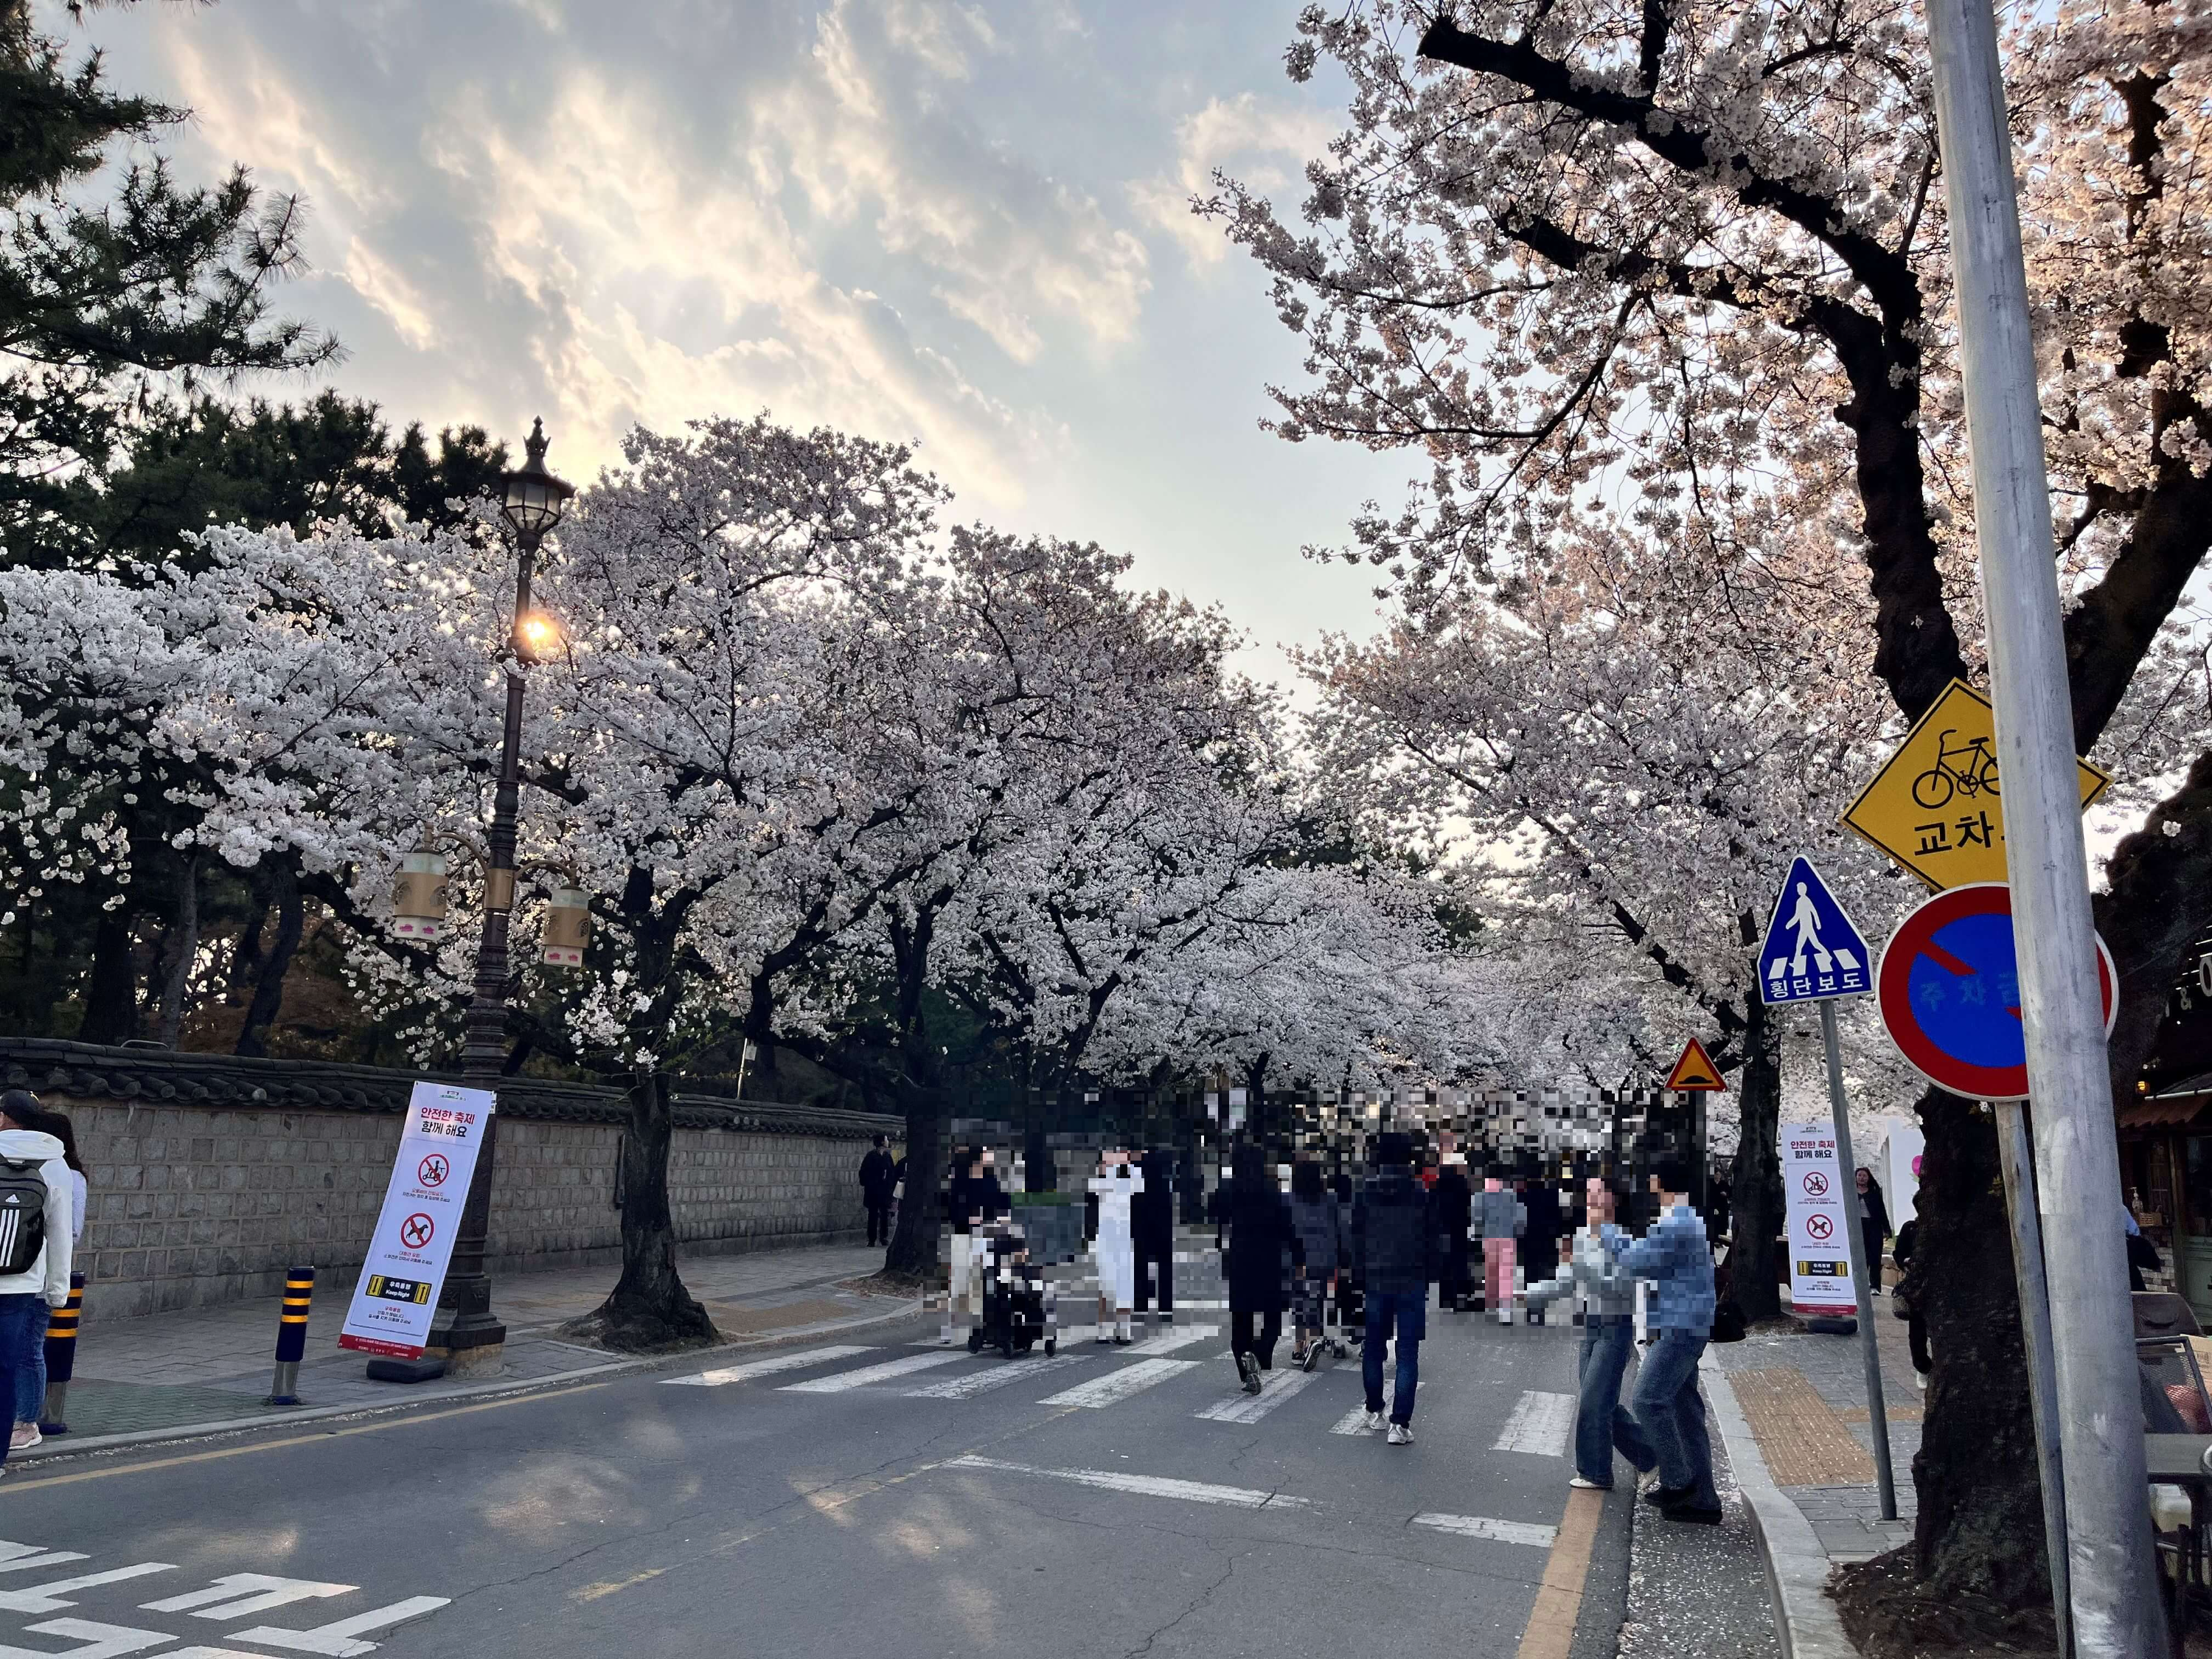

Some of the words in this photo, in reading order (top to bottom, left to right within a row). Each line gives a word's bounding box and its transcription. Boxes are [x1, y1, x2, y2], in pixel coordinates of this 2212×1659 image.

[1914, 810, 2005, 855] 교차
[1770, 973, 1863, 998] 횡단보도
[1920, 972, 2020, 1012] 주차금
[421, 1107, 452, 1121] 안전한
[454, 1112, 476, 1124] 축제
[421, 1121, 444, 1134] 함께
[445, 1124, 467, 1138] 해요
[1790, 1141, 1815, 1149] 안전한
[1818, 1140, 1835, 1148] 축제
[1795, 1150, 1812, 1158] 함께
[1815, 1150, 1832, 1158] 해요
